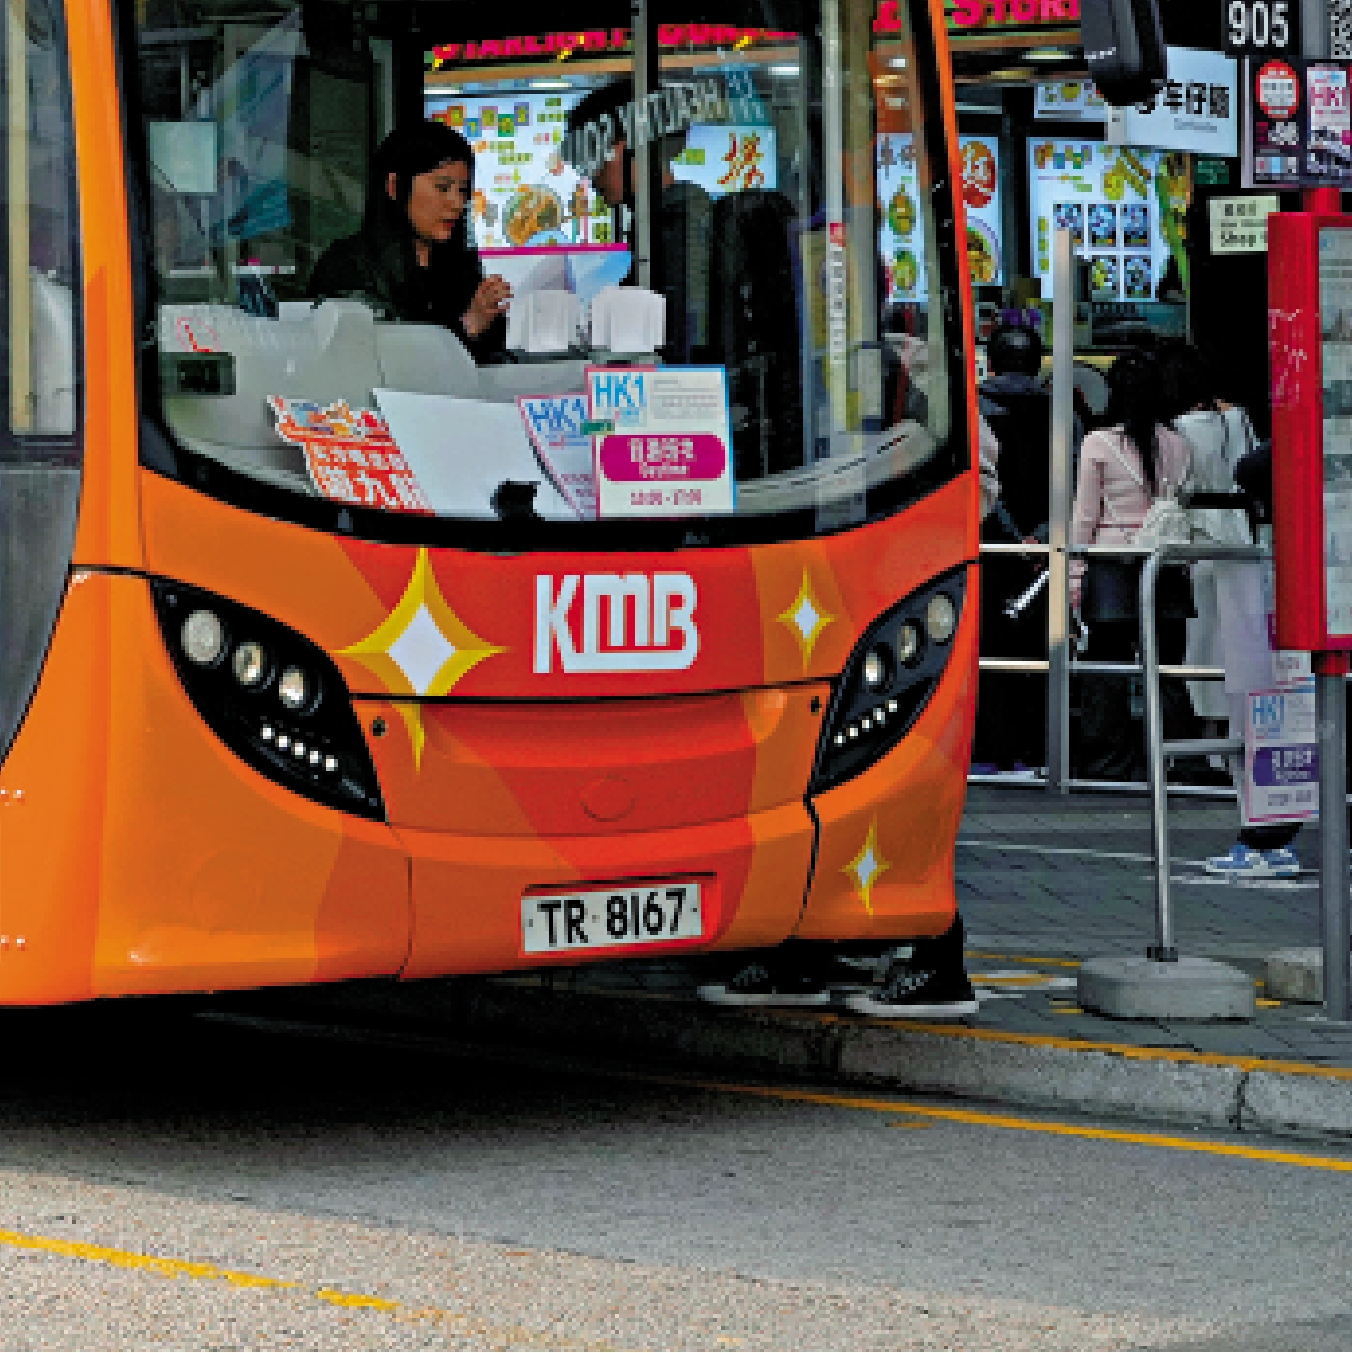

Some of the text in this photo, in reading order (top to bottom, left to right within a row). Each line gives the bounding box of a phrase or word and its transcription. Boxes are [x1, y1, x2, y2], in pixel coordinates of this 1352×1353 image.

[1228, 1, 1289, 48] 905
[594, 373, 646, 410] HK1
[525, 398, 588, 436] HK1
[533, 571, 698, 673] KMB
[537, 887, 686, 947] TR 8167
